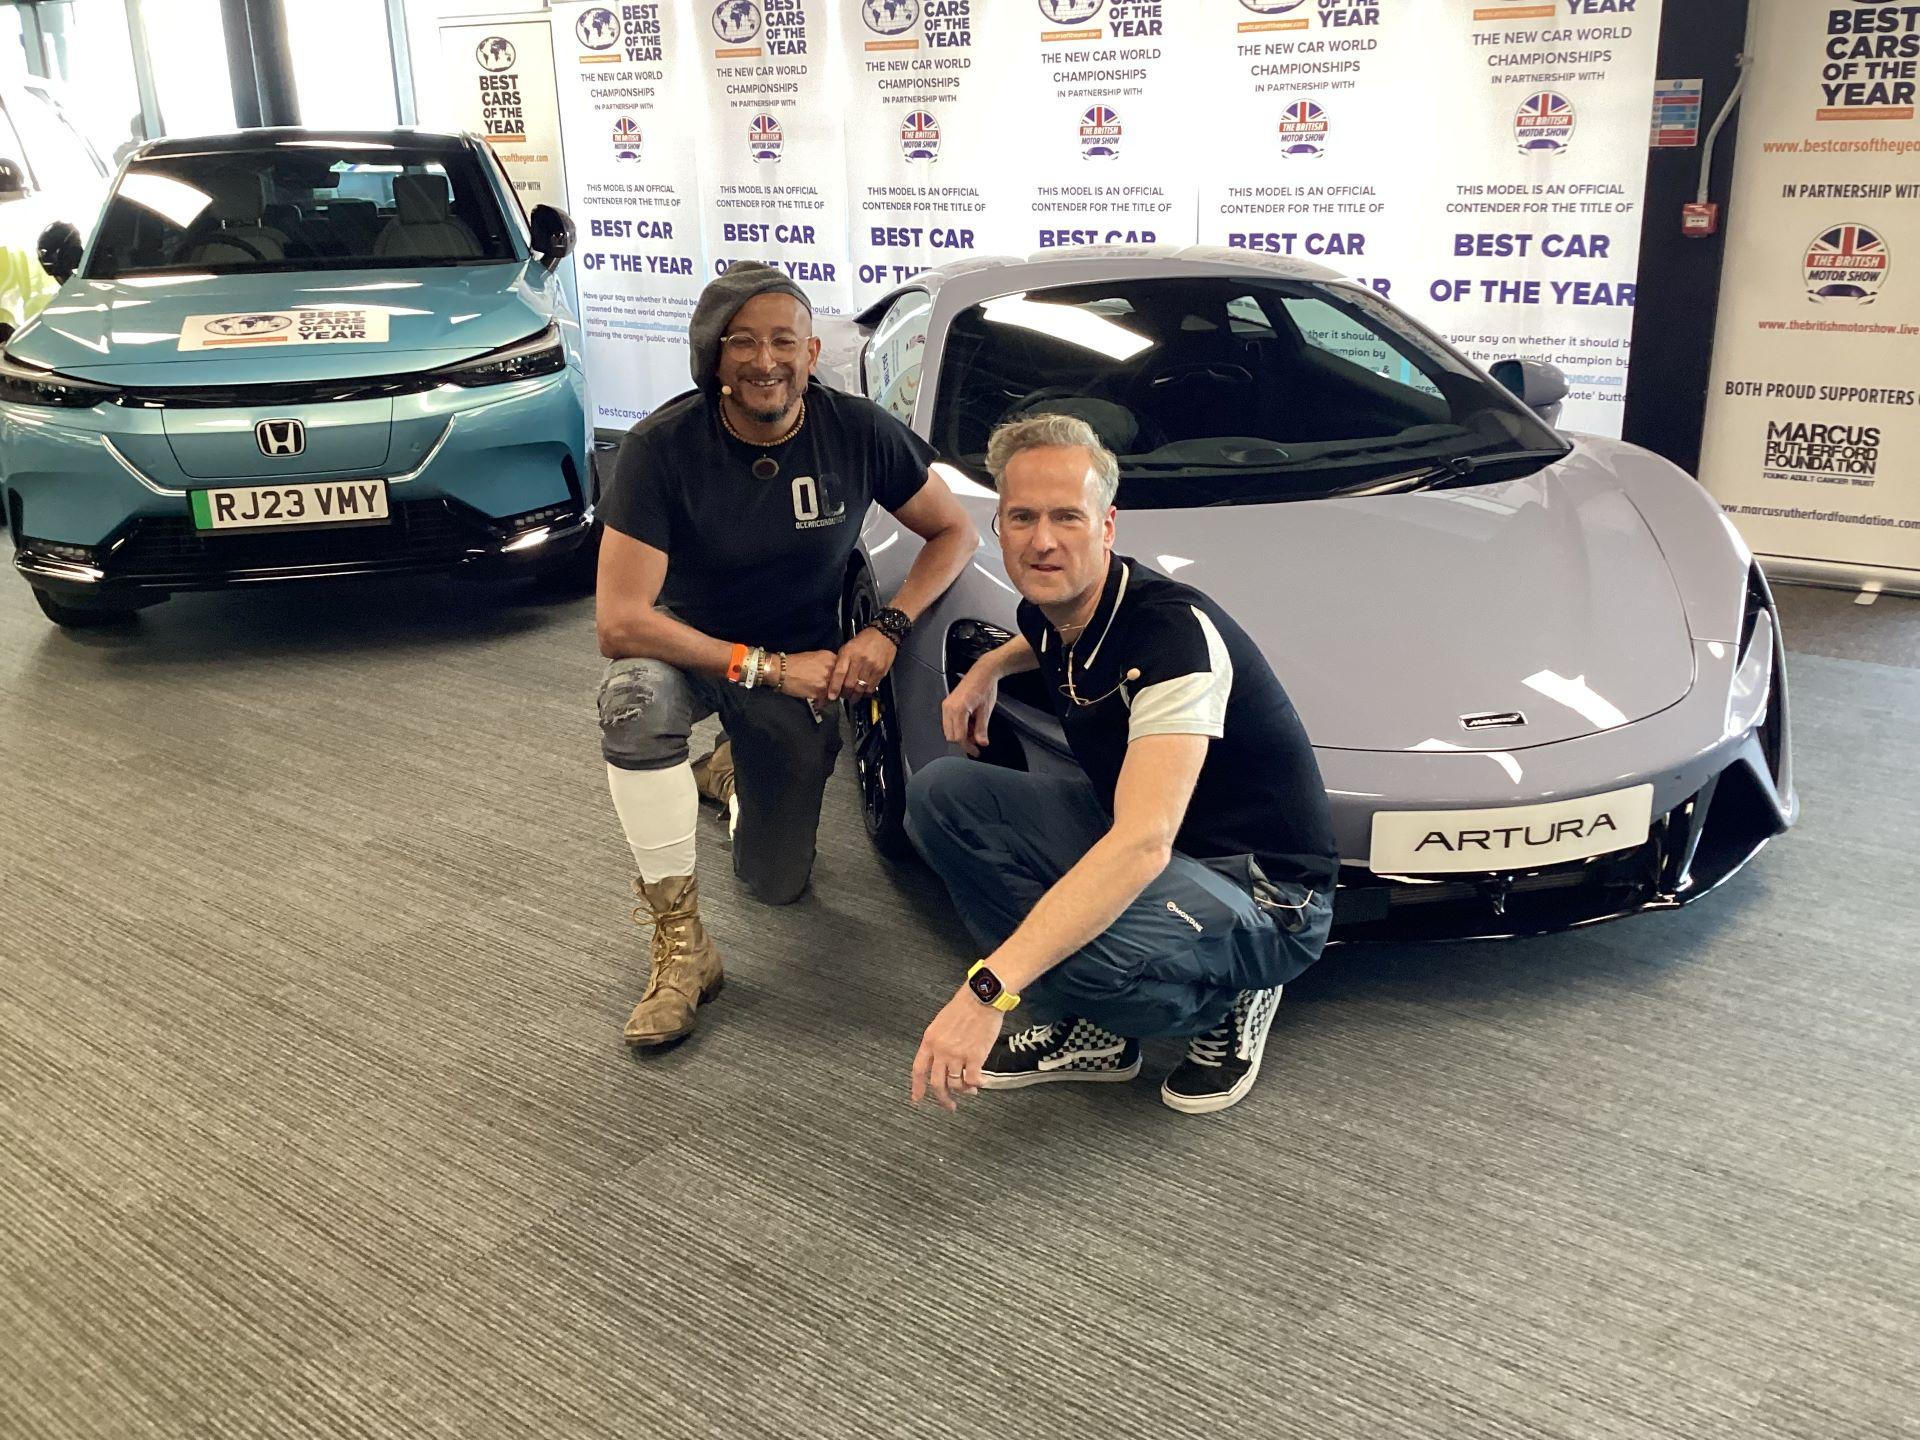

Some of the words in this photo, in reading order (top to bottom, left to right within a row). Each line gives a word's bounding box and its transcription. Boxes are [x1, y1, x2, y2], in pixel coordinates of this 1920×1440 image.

[622, 4, 658, 20] BEST
[924, 1, 969, 17] CARS
[1110, 7, 1128, 19] OF
[1132, 6, 1161, 18] THE
[1567, 0, 1635, 14] YEAR
[766, 11, 805, 27] CARS
[925, 20, 941, 31] OF
[944, 18, 970, 29] THE
[1318, 8, 1379, 27] YEAR
[1827, 7, 1920, 34] BEST
[624, 20, 660, 34] CARS
[766, 29, 780, 39] OF
[783, 27, 805, 38] THE
[1110, 20, 1162, 37] YEAR
[625, 37, 638, 47] OF
[641, 36, 661, 46] THE
[926, 32, 971, 48] YEAR
[1473, 33, 1500, 45] THE
[1505, 31, 1538, 43] NEW
[1542, 30, 1572, 42] CAR
[1578, 27, 1632, 40] WORLD
[626, 47, 662, 61] YEAR
[767, 40, 807, 55] YEAR
[1238, 45, 1261, 56] THE
[1266, 43, 1294, 55] NEW
[1298, 42, 1324, 53] CAR
[1328, 39, 1377, 51] WORLD
[1826, 34, 1920, 60] CARS
[1042, 53, 1061, 63] THE
[1065, 52, 1089, 62] NEW
[1093, 50, 1116, 61] CAR
[1120, 49, 1161, 60] WORLD
[1488, 50, 1611, 66] CHAMPIONSHIPS
[1054, 69, 1146, 82] CHAMPIONSHIPS
[1251, 61, 1360, 76] CHAMPIONSHIPS
[1823, 63, 1858, 80] OF
[1865, 61, 1917, 79] THE
[479, 75, 518, 90] BEST
[581, 74, 595, 82] THE
[598, 72, 614, 81] NEW
[617, 72, 632, 81] CAR
[635, 71, 663, 80] WORLD
[879, 78, 960, 89] CHAMPIONSHIPS
[1492, 76, 1501, 84] IN
[1505, 73, 1575, 83] PARTNERSHIP
[1578, 72, 1604, 80] WITH
[591, 88, 654, 98] CHAMPIONSHIPS
[1267, 82, 1328, 91] PARTNERSHIP
[1331, 81, 1355, 89] WITH
[1822, 82, 1915, 105] YEAR
[482, 92, 521, 106] CARS
[483, 108, 497, 118] OF
[500, 107, 522, 118] THE
[485, 120, 525, 134] YEAR
[1521, 117, 1534, 125] THE
[1536, 116, 1568, 125] BRITISH
[1518, 129, 1544, 137] MOTOR
[1545, 128, 1569, 136] SHOW
[1764, 138, 1920, 155] www.bestcarsoftheyea
[528, 182, 541, 190] WITH
[1229, 188, 1252, 197] THIS
[1256, 187, 1292, 196] MODEL
[1295, 187, 1304, 196] IS
[1307, 187, 1323, 196] AN
[1327, 186, 1376, 195] OFFICIAL
[1457, 186, 1483, 195] THIS
[1487, 185, 1528, 195] MODEL
[1532, 185, 1543, 194] IS
[1547, 185, 1564, 194] AN
[1569, 185, 1624, 194] OFFICIAL
[1783, 185, 1795, 198] IN
[1800, 184, 1891, 198] PARTNERSHIP
[1896, 184, 1920, 198] WIT
[1221, 204, 1285, 213] CONTENDER
[1288, 204, 1309, 213] FOR
[1313, 204, 1334, 213] THE
[1338, 204, 1365, 212] TITLE
[1369, 203, 1384, 212] OF
[1446, 203, 1520, 213] CONTENDER
[1524, 203, 1548, 213] FOR
[1552, 203, 1576, 213] THE
[1580, 203, 1611, 213] TITLE
[1616, 203, 1633, 213] OF
[591, 219, 632, 238] BEST
[637, 221, 673, 239] CAR
[724, 224, 769, 242] BEST
[775, 225, 815, 244] CAR
[871, 227, 923, 247] BEST
[930, 228, 974, 248] CAR
[1040, 230, 1098, 247] BEST
[1229, 233, 1297, 254] BEST
[1305, 233, 1365, 255] CAR
[1454, 234, 1533, 257] BEST
[1542, 234, 1610, 258] CAR
[583, 253, 605, 270] OF
[610, 254, 642, 272] THE
[646, 256, 693, 275] YEAR
[1813, 255, 1833, 266] THE
[1835, 256, 1880, 267] BRITISH
[785, 261, 835, 281] YEAR
[859, 265, 887, 283] OF
[1809, 270, 1846, 280] MOTOR
[1847, 271, 1880, 282] SHOW
[636, 294, 661, 303] whether
[668, 297, 687, 305] should
[689, 297, 697, 305] be
[1430, 279, 1471, 302] OF
[1480, 280, 1540, 303] THE
[1550, 282, 1637, 306] YEAR
[300, 317, 366, 325] CARS
[1759, 320, 1919, 335] www.thebritishmotorshow.live
[299, 331, 366, 340] YEAR
[1332, 330, 1338, 339] it
[1341, 331, 1374, 341] should
[1451, 334, 1475, 343] your
[1479, 335, 1498, 344] say
[1519, 336, 1565, 345] whether
[1569, 336, 1576, 346] it
[1580, 337, 1619, 347] should
[1373, 348, 1385, 359] by
[1556, 355, 1612, 366] champion
[1616, 356, 1629, 368] by
[1725, 381, 1762, 396] BOTH
[1766, 383, 1815, 399] PROUD
[1820, 386, 1914, 405] SUPPORTERS
[1767, 421, 1880, 447] MARCUS
[1766, 441, 1877, 460] RUTHERFORD
[1765, 454, 1876, 475] FOUNDATION
[215, 490, 304, 521] RJ23
[315, 485, 377, 515] VMY
[1414, 813, 1616, 851] ARTURA
[1174, 908, 1203, 932] MONTANE
